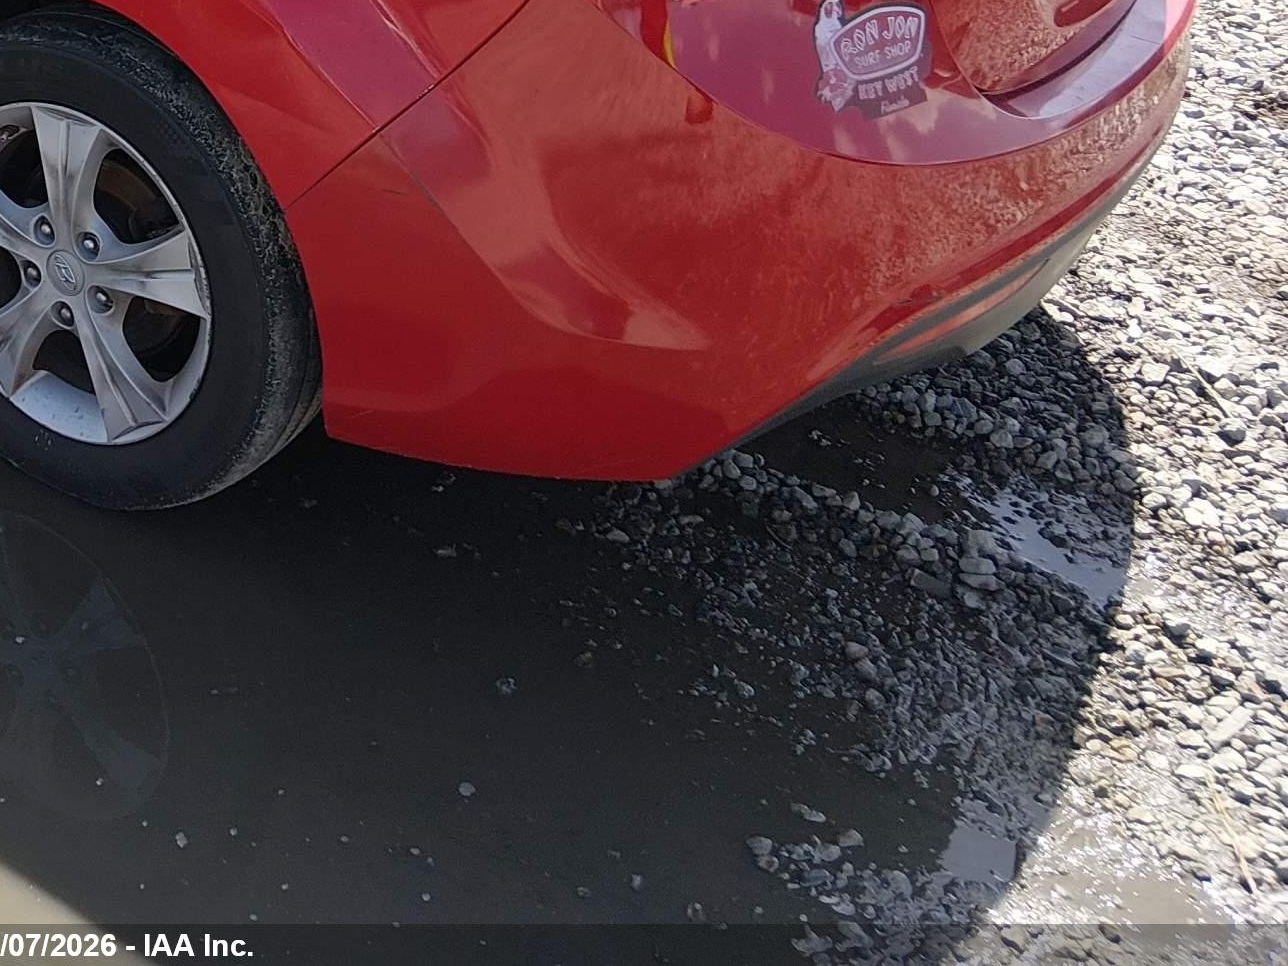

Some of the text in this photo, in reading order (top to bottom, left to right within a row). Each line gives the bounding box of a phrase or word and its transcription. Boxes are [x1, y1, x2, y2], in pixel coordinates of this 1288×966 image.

[840, 16, 918, 62] RON JON
[854, 40, 912, 69] SURF SHOP
[857, 81, 883, 100] KEY
